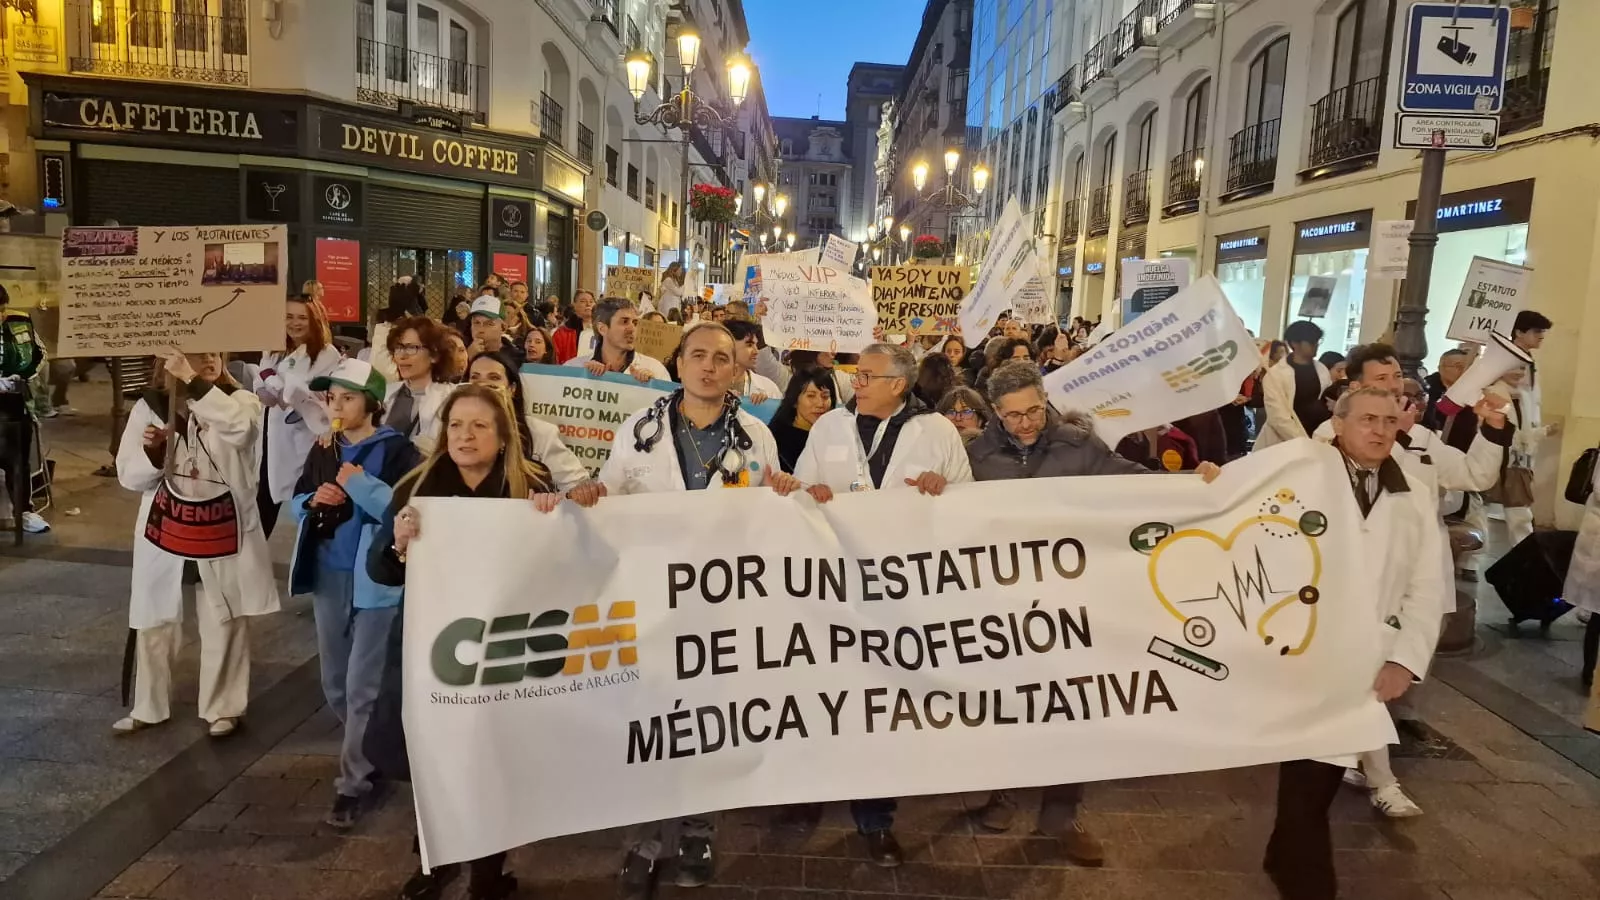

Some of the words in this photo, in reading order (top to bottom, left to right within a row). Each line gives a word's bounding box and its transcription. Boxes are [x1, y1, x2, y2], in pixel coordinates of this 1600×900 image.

[1407, 82, 1442, 95] ZONA
[1444, 83, 1499, 96] VIGILADA
[79, 97, 263, 139] CAFETERIA
[341, 124, 424, 160] DEVIL
[432, 139, 518, 174] COFFEE
[1437, 199, 1502, 219] OMARTINEZ
[154, 230, 165, 243] Y
[172, 231, 190, 241] LOS
[1301, 222, 1356, 239] PACOMARTINEZ
[877, 267, 892, 282] YA
[896, 268, 932, 284] SOY
[938, 270, 960, 285] UN
[1144, 264, 1170, 273] HUELGA
[158, 279, 189, 288] TIEMPO
[1477, 281, 1517, 297] ESTATUTO
[877, 302, 896, 315] ME
[1483, 298, 1512, 312] PROPIO
[562, 386, 593, 401] POR
[597, 390, 620, 404] UN
[532, 402, 595, 420] ESTATUTO
[559, 424, 615, 442] PROPIO
[170, 498, 234, 522] VENDE
[668, 555, 768, 608] POR
[784, 557, 846, 602] UN
[860, 538, 1085, 601] ESTATUTO
[430, 600, 637, 686] CESM
[676, 629, 738, 680] DE
[756, 623, 816, 669] LA
[830, 592, 1092, 670] PROFESIÓN
[430, 690, 490, 704] Sindicato
[494, 688, 510, 701] de
[514, 684, 567, 700] Médicos
[570, 680, 584, 693] de
[586, 668, 640, 690] ARAGÓN
[627, 698, 808, 764] MÉDICA
[818, 691, 848, 735] Y
[865, 664, 1177, 732] FACULTATIVA
